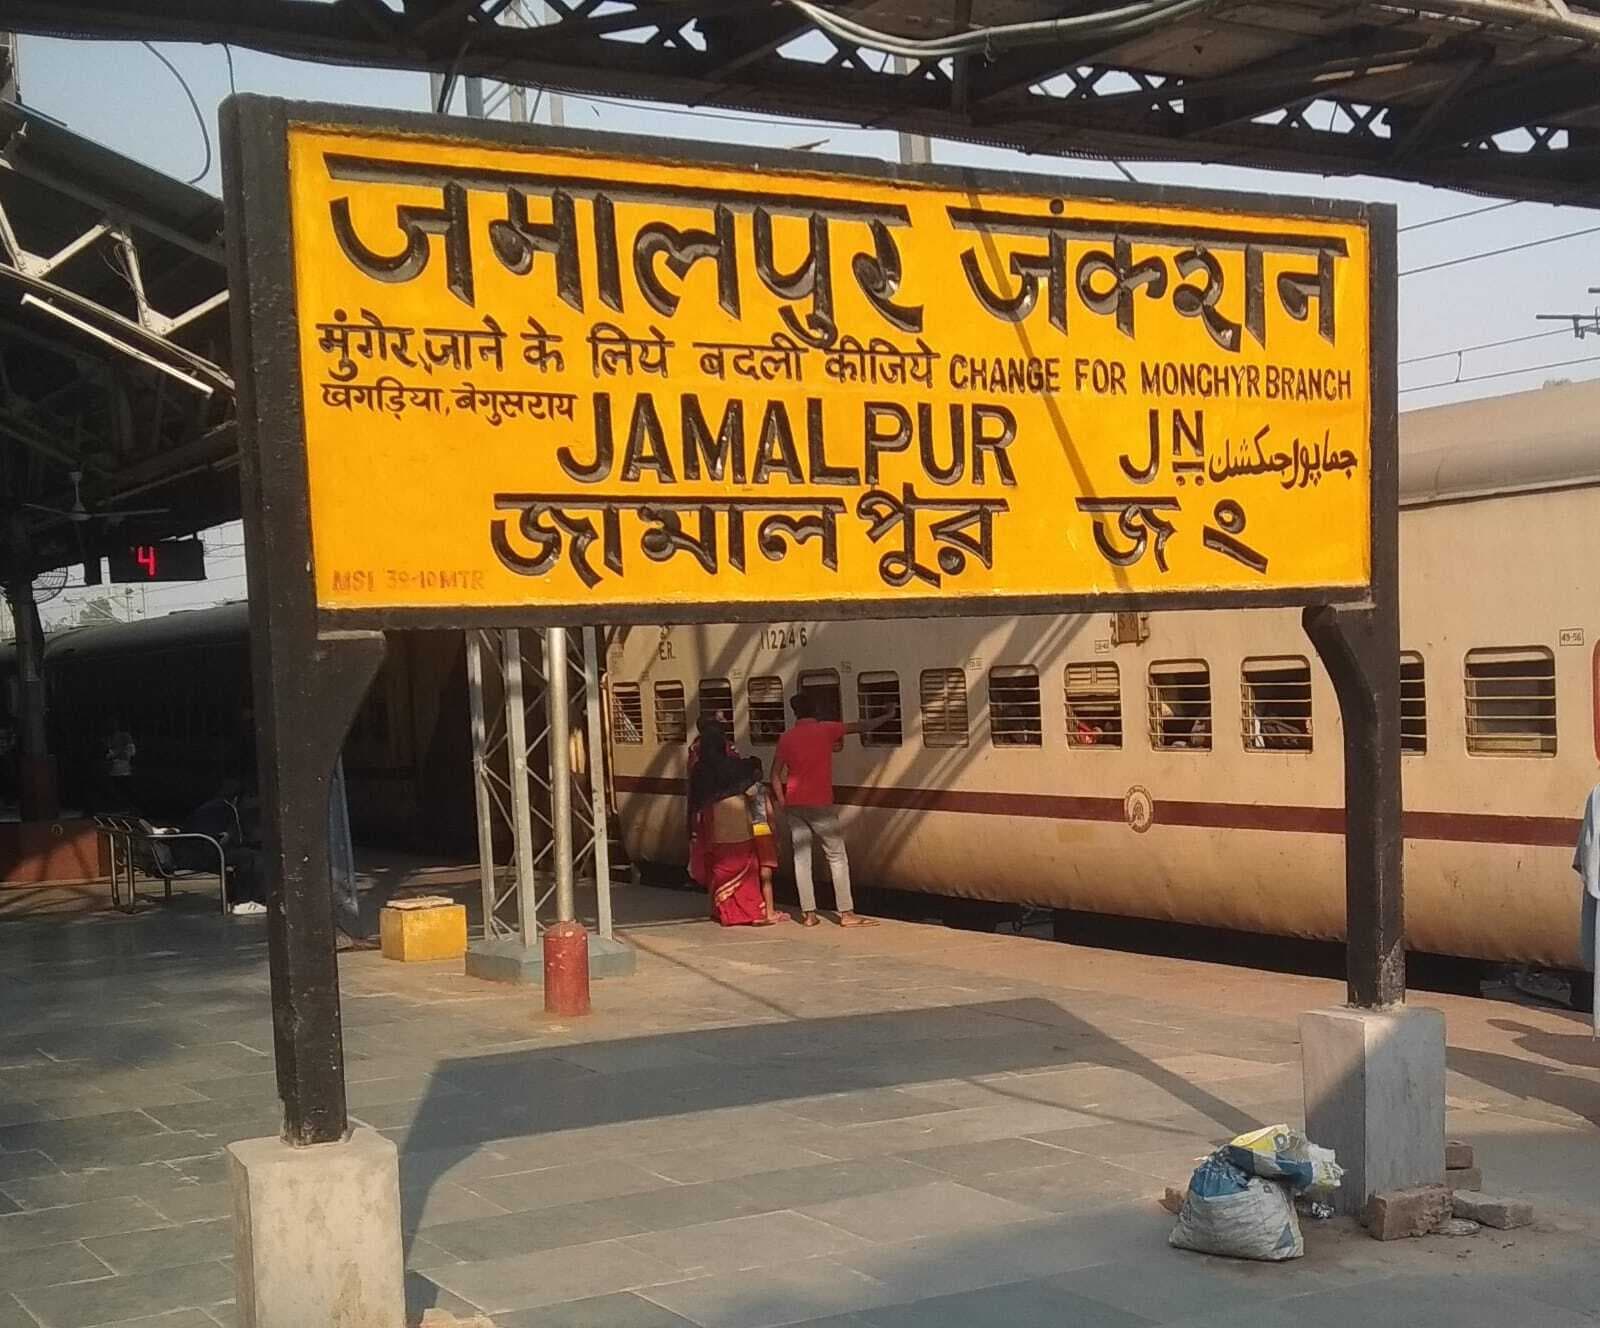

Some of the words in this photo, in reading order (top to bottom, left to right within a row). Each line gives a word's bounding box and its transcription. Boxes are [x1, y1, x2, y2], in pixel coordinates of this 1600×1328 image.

[323, 153, 924, 348] जमालपुर
[945, 199, 1349, 352] जंकशन
[520, 316, 565, 373] के
[585, 322, 675, 379] लिये
[693, 332, 809, 382] बदली
[824, 335, 940, 389] कीजिये
[949, 354, 1060, 394] CHANGE
[1075, 358, 1127, 395] FOR
[1265, 365, 1352, 402] BRANCH
[557, 392, 1018, 484] JAMALPUR
[138, 545, 156, 577] 4
